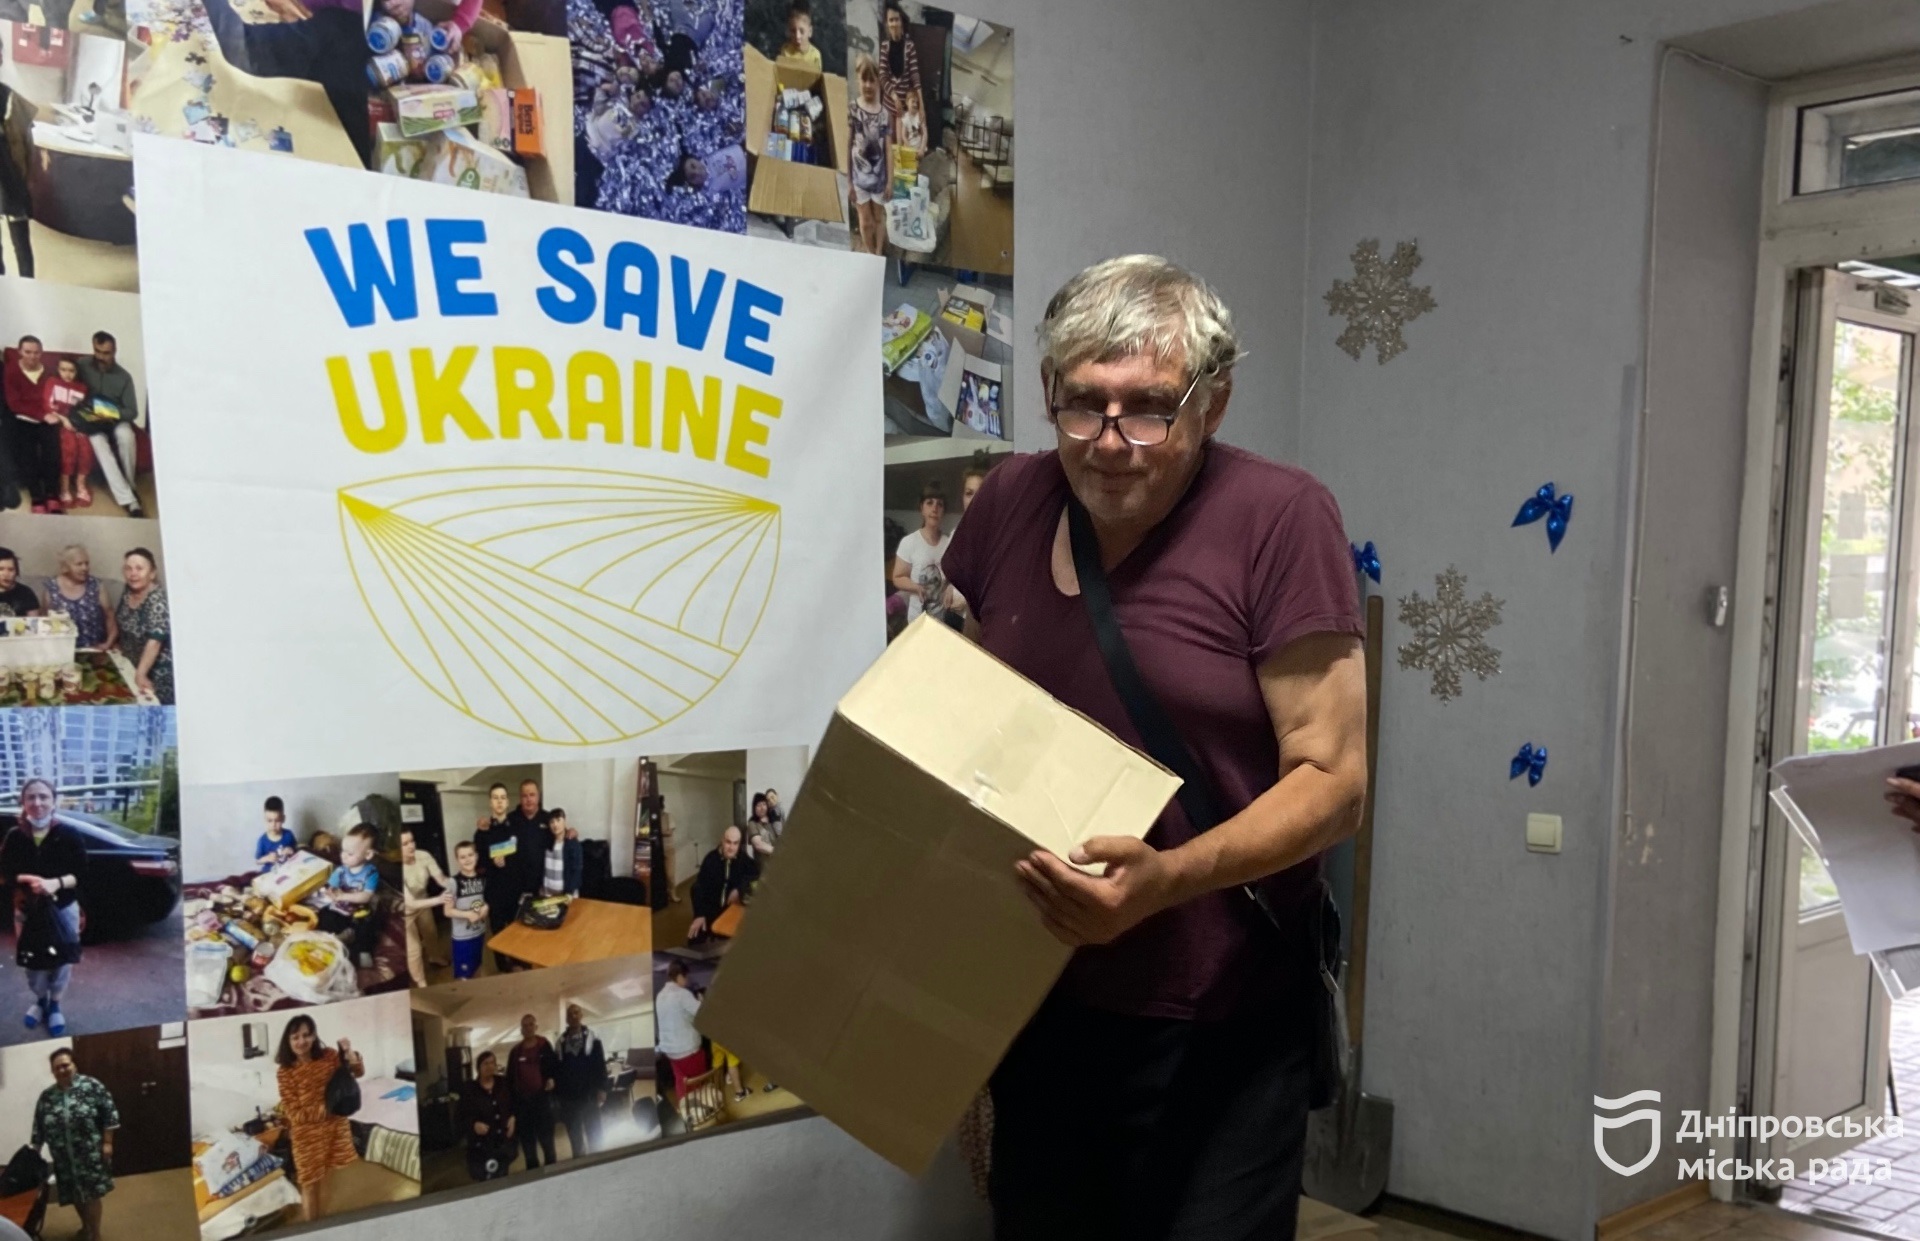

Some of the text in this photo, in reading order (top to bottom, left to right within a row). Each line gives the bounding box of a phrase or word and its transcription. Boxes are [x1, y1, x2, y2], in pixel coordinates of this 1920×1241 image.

[304, 218, 783, 375] WE SAVE
[325, 345, 783, 478] UKRAINE
